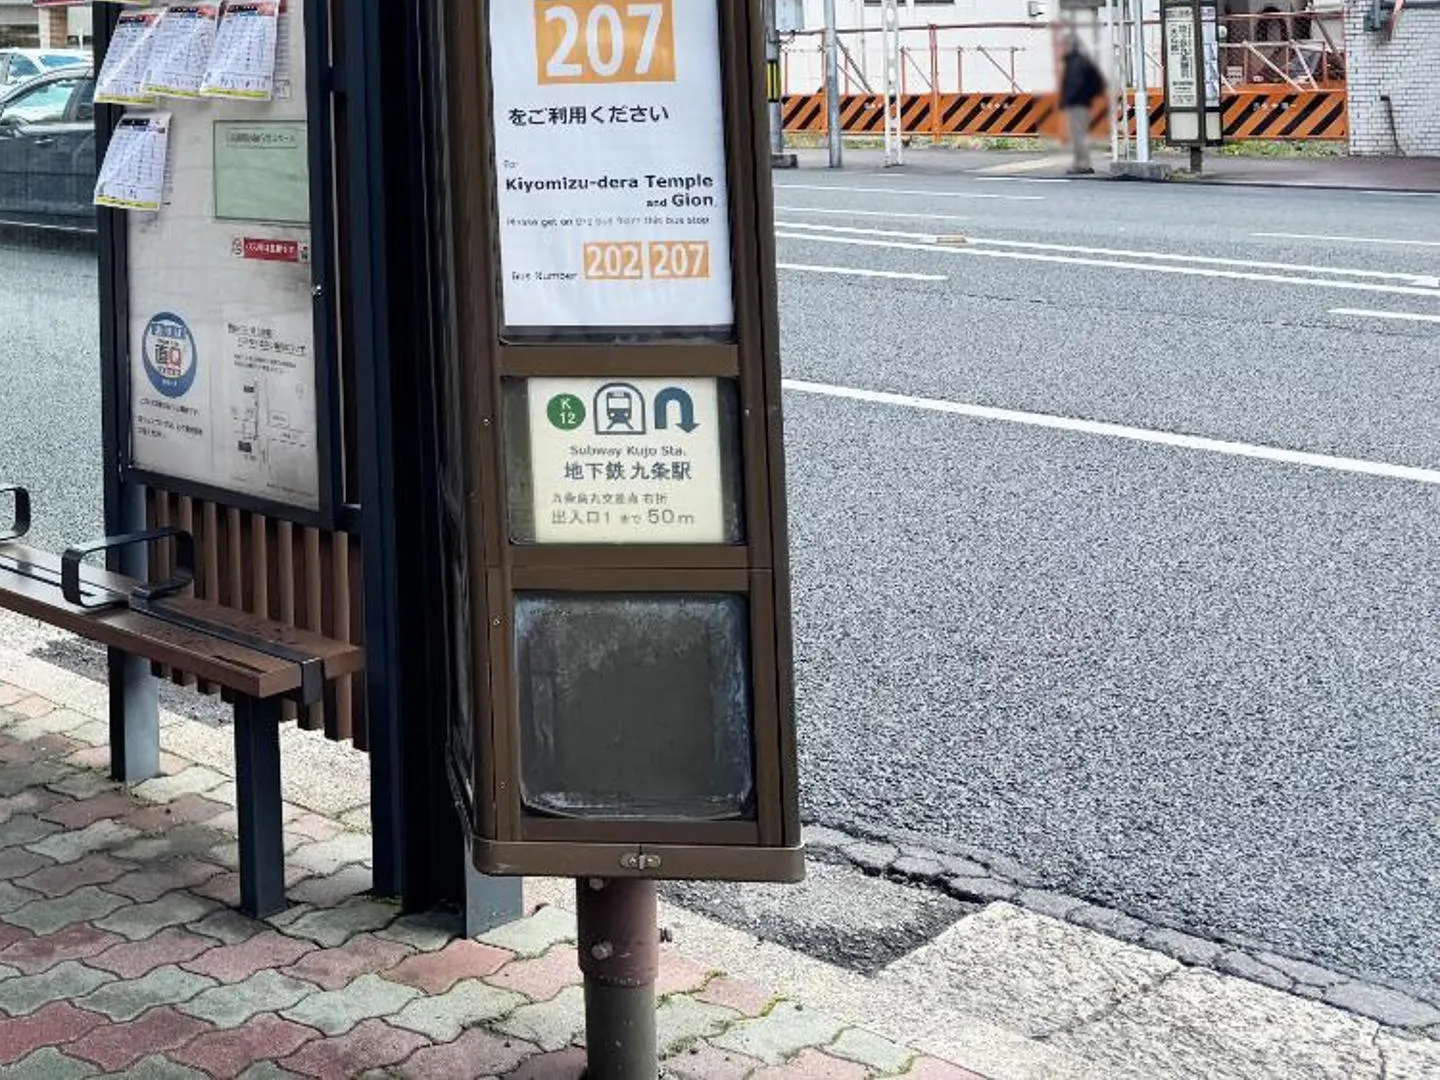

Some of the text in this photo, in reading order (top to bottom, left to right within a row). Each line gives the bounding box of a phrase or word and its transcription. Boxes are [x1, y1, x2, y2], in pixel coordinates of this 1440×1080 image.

[544, 2, 664, 77] 207
[508, 104, 670, 127] をご利用ください
[505, 173, 714, 194] Kiyomizu-dera Temple
[646, 197, 667, 208] and
[586, 245, 641, 277] 202
[653, 244, 706, 277] 207
[561, 398, 571, 409] K
[560, 413, 577, 425] 12
[570, 445, 622, 459] Subway
[627, 445, 658, 459] Kujo
[647, 508, 695, 525] 50m
